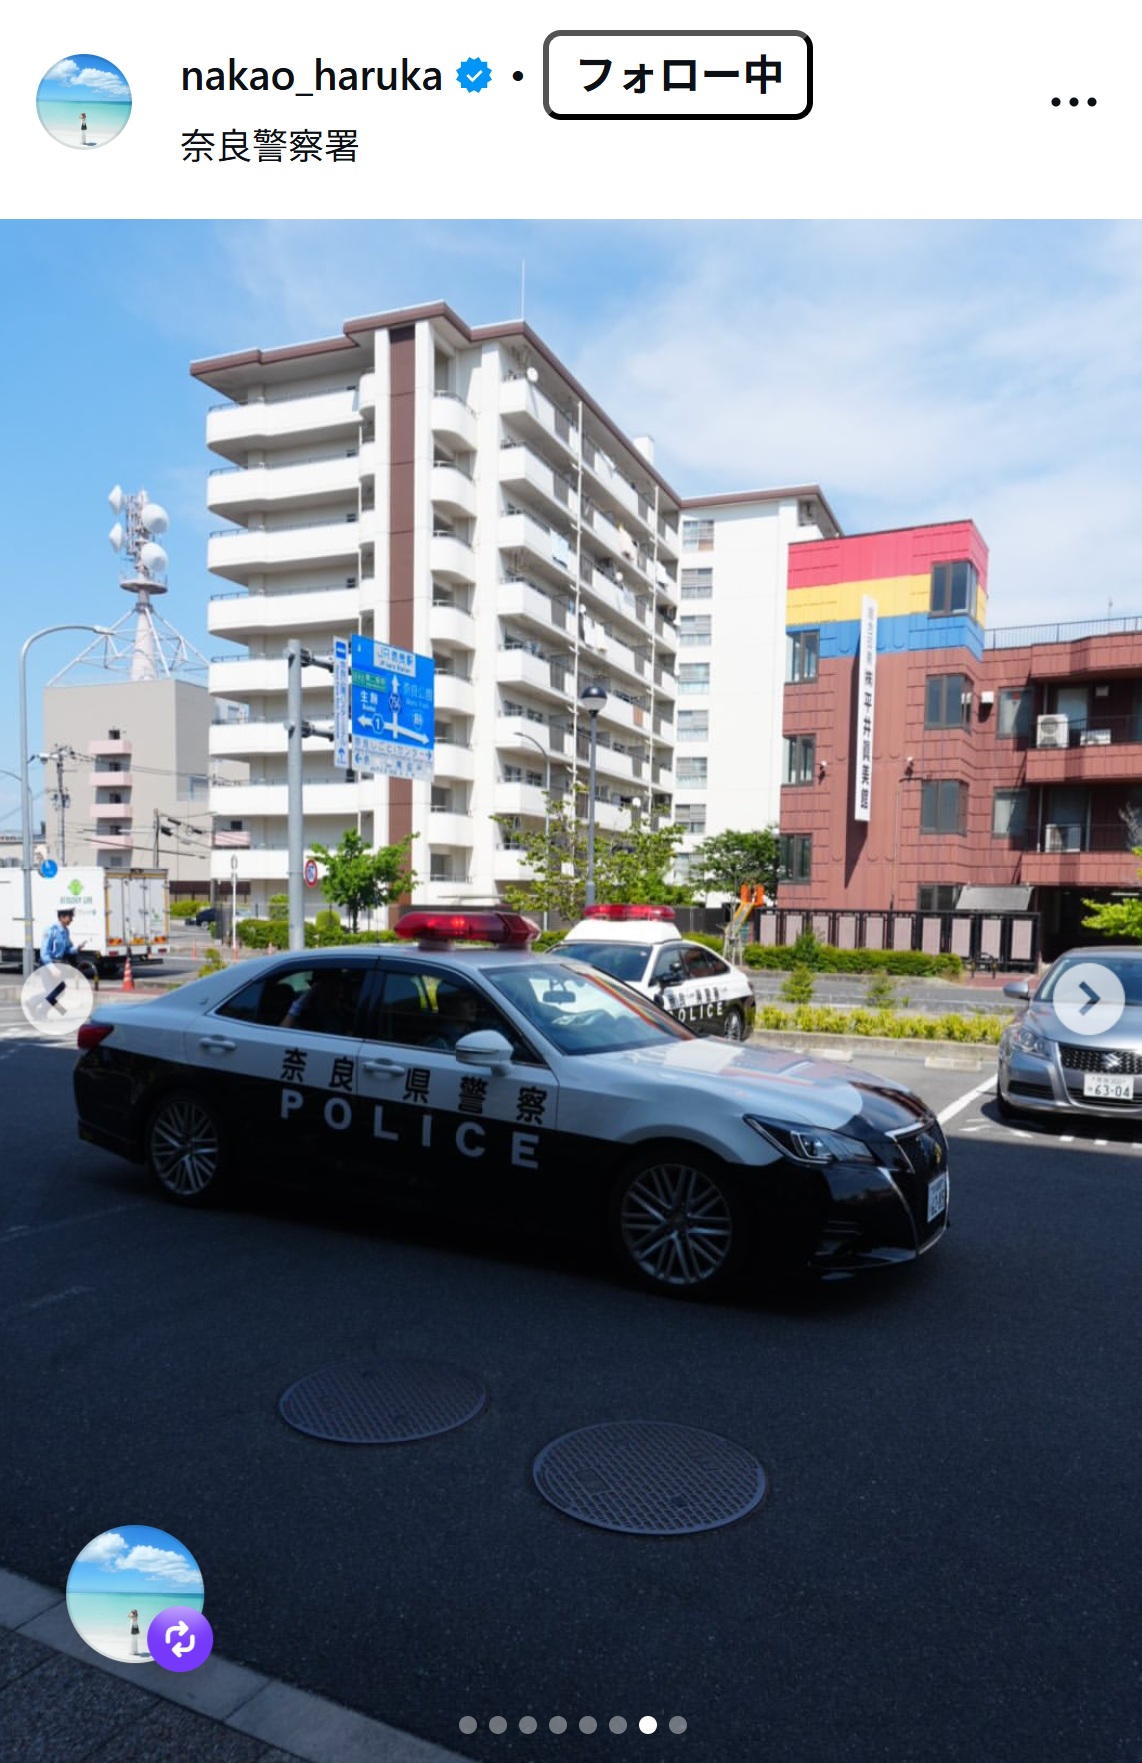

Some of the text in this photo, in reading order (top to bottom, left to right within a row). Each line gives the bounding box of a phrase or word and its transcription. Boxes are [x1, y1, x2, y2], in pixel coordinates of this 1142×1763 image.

[669, 1002, 723, 1023] OLICE
[280, 1048, 547, 1125] 奈良県警察
[280, 1089, 540, 1169] POLICE
